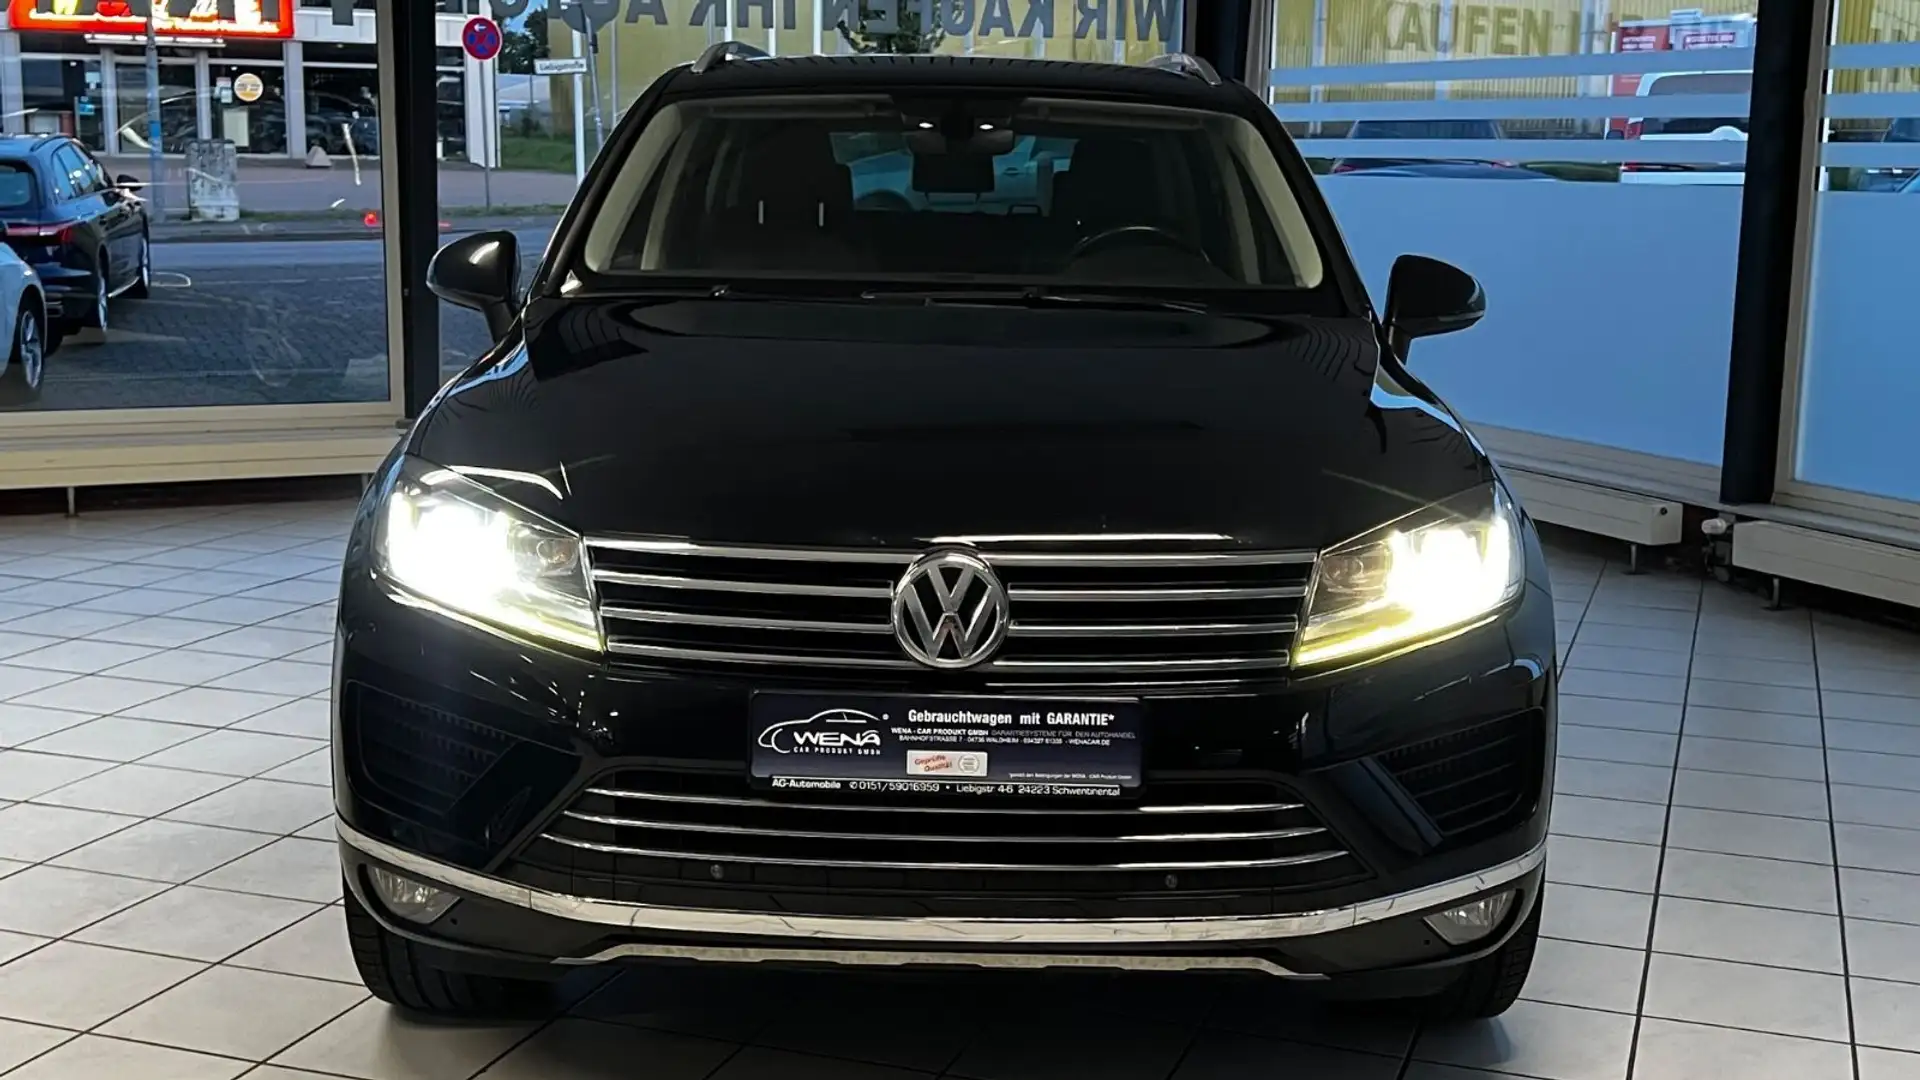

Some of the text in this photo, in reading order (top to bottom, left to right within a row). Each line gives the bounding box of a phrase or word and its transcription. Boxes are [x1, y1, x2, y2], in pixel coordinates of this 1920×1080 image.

[908, 709, 1012, 726] Gebrauchtwagen
[1020, 712, 1040, 725] mit
[793, 730, 881, 746] WENA
[814, 747, 853, 755] PRODUKT
[772, 778, 841, 789] AG-Automobile
[1018, 785, 1051, 794] 24223
[1052, 786, 1121, 796] Schwentinental
